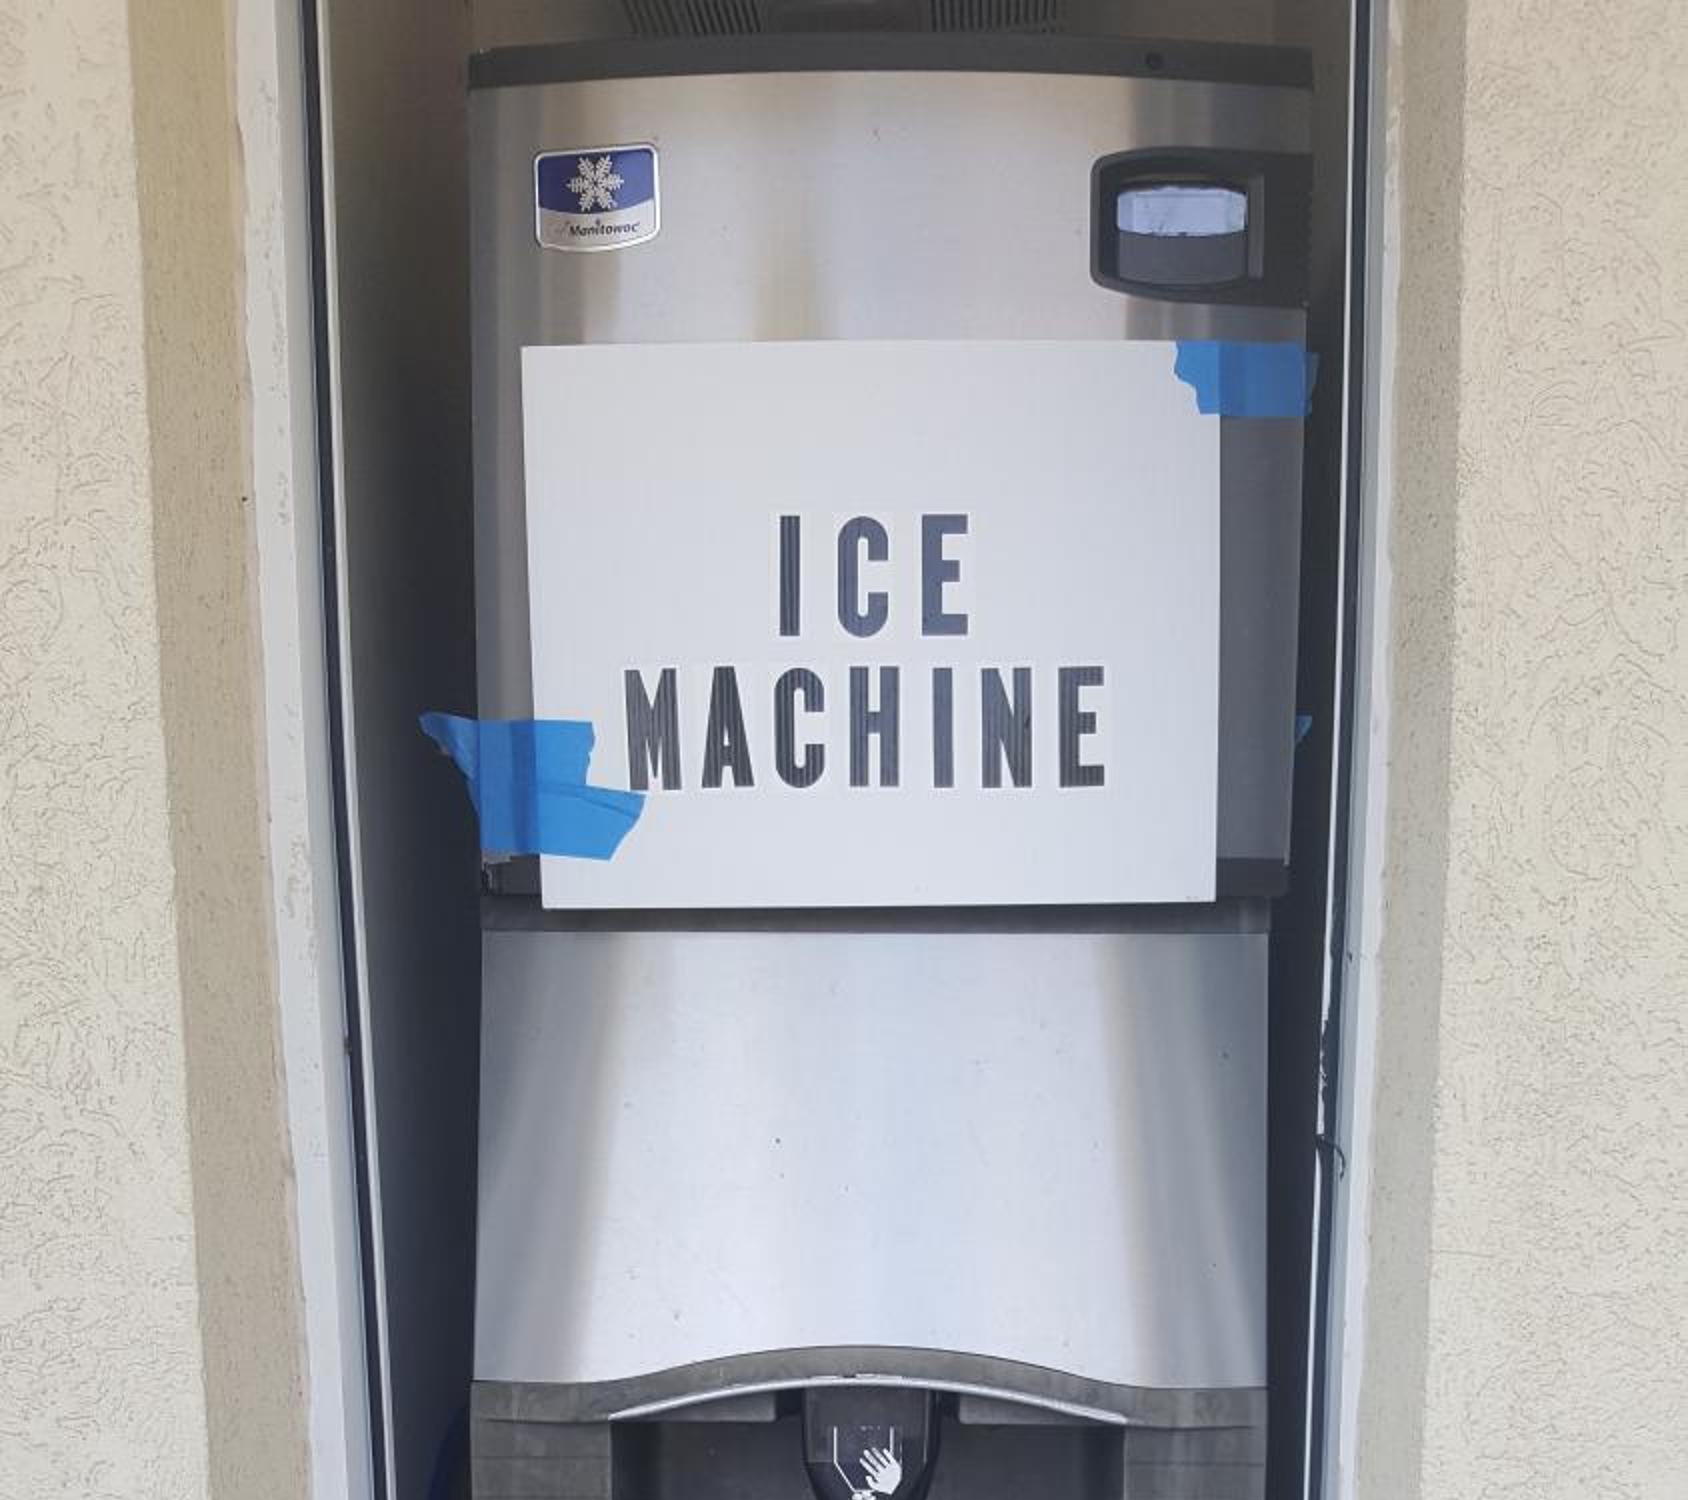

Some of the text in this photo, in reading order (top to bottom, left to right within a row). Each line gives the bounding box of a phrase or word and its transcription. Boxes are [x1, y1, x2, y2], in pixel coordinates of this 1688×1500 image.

[568, 218, 640, 237] Manitowoc
[780, 514, 968, 637] ICE
[624, 666, 1104, 790] MACHINE
